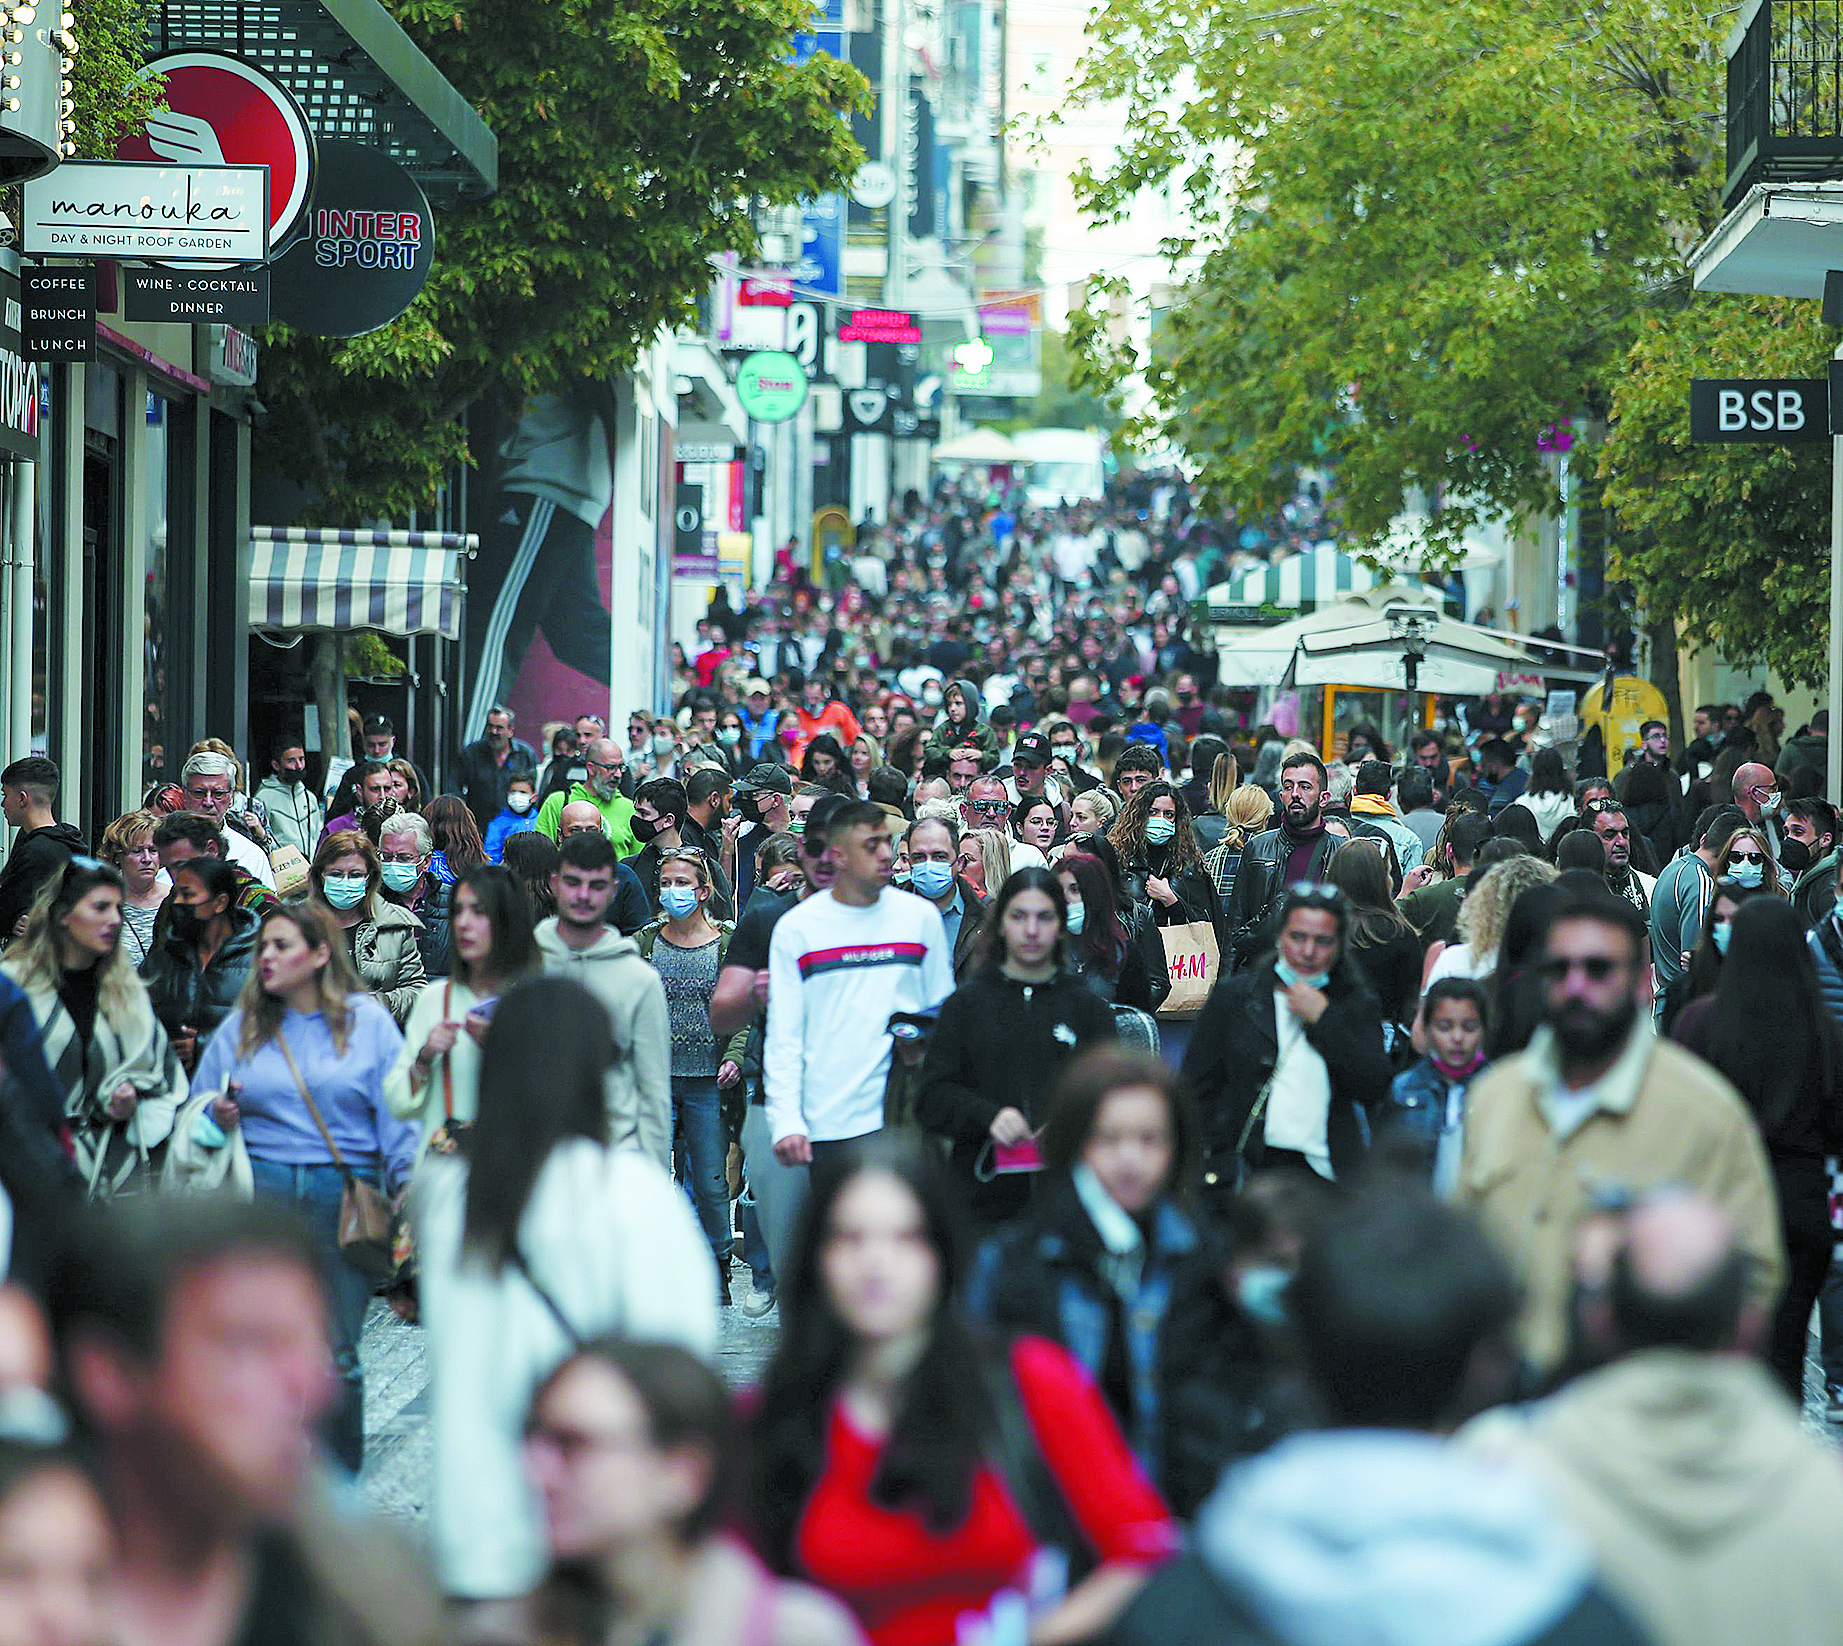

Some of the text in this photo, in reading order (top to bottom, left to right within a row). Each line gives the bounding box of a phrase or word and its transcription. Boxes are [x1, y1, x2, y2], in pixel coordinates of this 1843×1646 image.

[52, 174, 241, 225] manouka
[317, 209, 420, 241] INTER
[51, 234, 232, 249] DAY & NIGHT ROOF GARDEN
[315, 238, 421, 270] SPORT
[30, 279, 86, 290] COFFEE
[136, 278, 258, 292] WINE COCKTAIL
[30, 309, 86, 320] BRUNCH
[170, 302, 224, 315] DINNER
[30, 340, 86, 350] LUNCH
[1718, 389, 1806, 431] BSB
[1168, 951, 1206, 980] H&M
